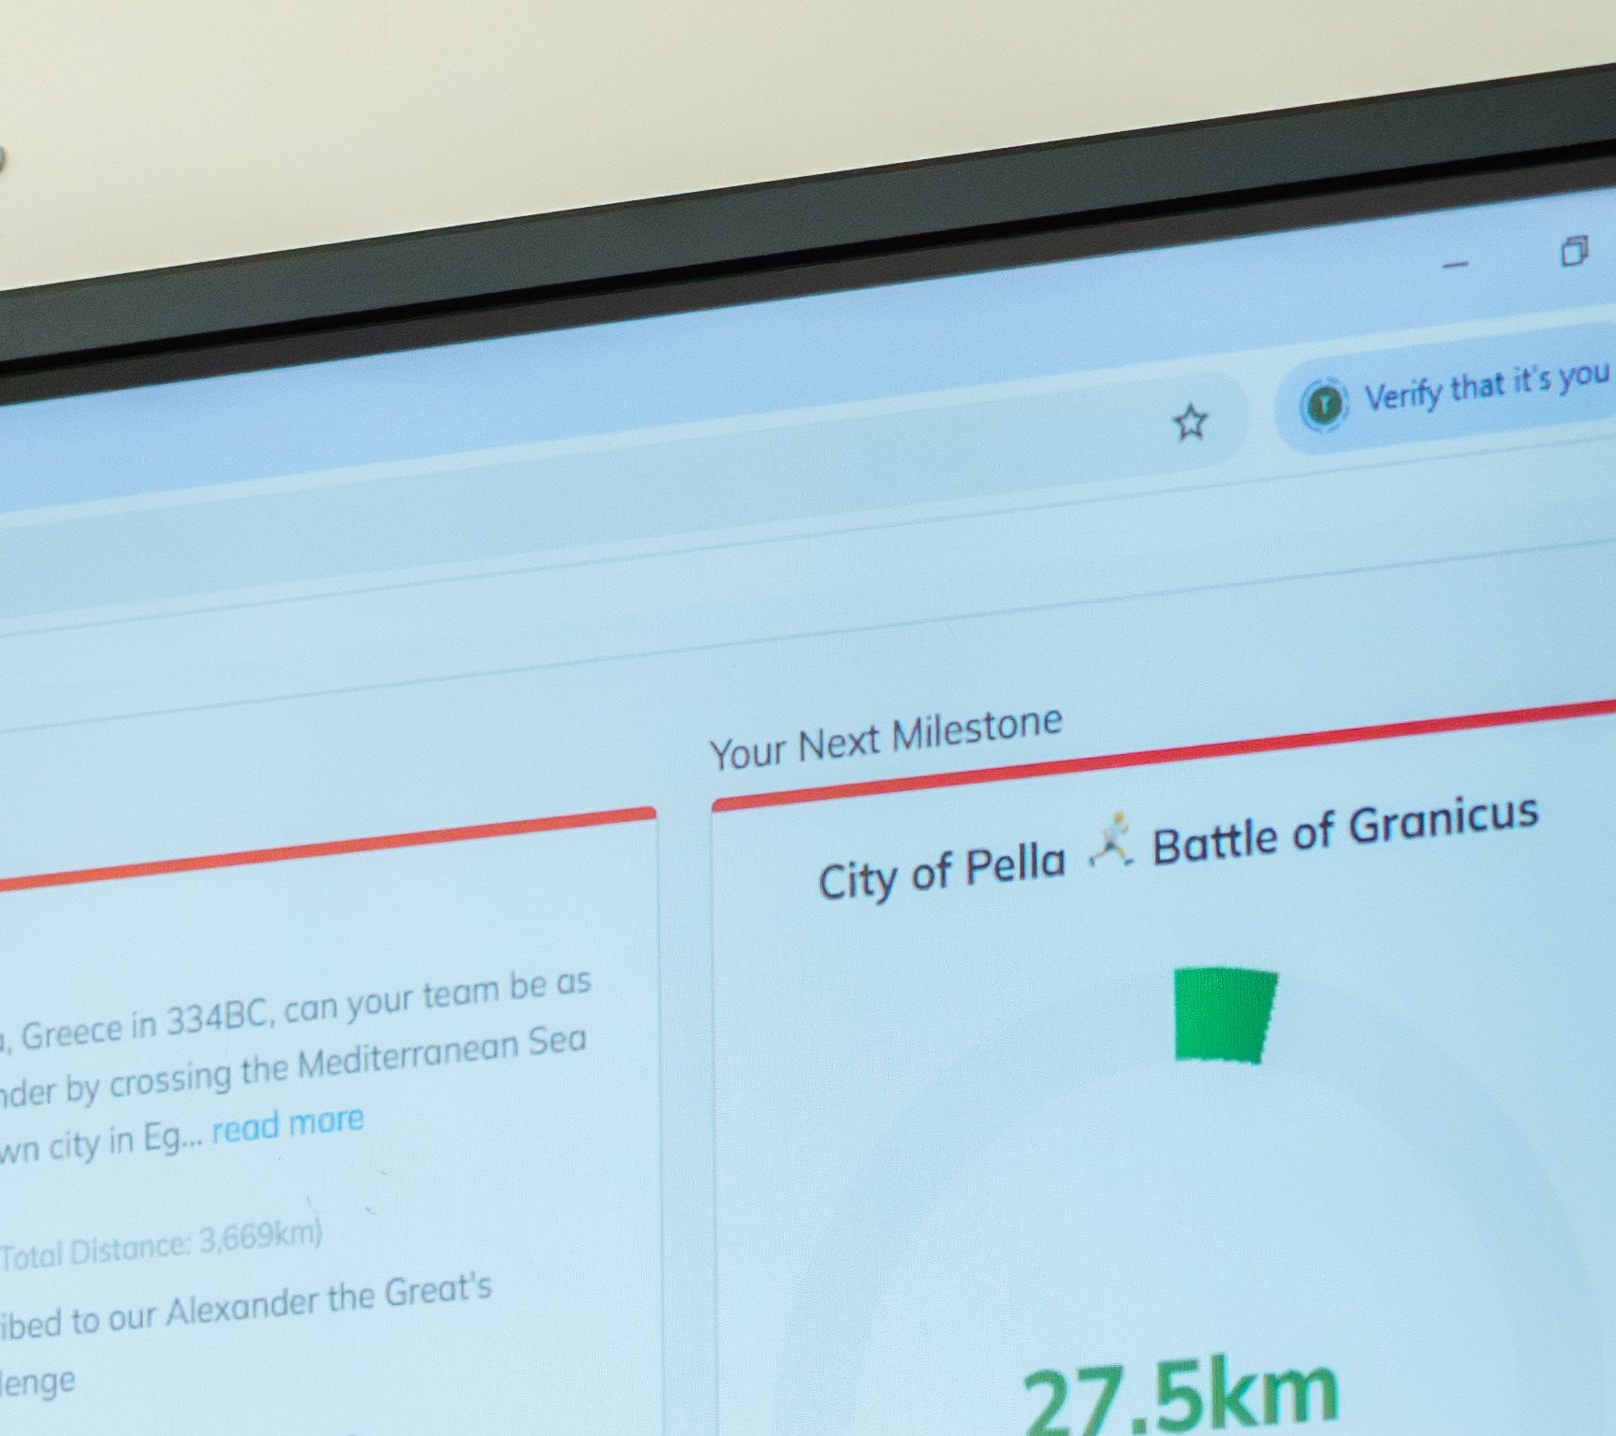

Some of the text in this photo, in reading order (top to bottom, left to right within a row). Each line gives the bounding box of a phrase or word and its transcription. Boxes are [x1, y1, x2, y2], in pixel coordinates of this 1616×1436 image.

[1363, 363, 1610, 415] Verify that it's you
[708, 709, 1064, 772] Your Next Milestone
[819, 796, 1540, 907] City of Pella Battle of Granicus
[21, 1020, 123, 1051] Greece
[131, 1010, 158, 1040] in
[167, 996, 276, 1037] 334BC,
[283, 997, 338, 1024] can
[346, 989, 415, 1026] your
[422, 980, 500, 1010] team
[510, 970, 548, 1001] be
[556, 970, 592, 996] as
[66, 1073, 101, 1109] by
[109, 1061, 232, 1099] crossing
[240, 1055, 289, 1086] the
[297, 1035, 520, 1079] Mediterranean
[528, 1025, 587, 1057] Sea
[49, 1130, 102, 1166] city
[109, 1125, 135, 1155] in
[212, 1109, 281, 1144] read
[289, 1108, 365, 1136] more
[69, 1235, 192, 1266] Distance:
[70, 1308, 101, 1335] to
[107, 1306, 158, 1333] our
[165, 1287, 320, 1327] Alexander
[326, 1282, 376, 1313] the
[384, 1270, 493, 1308] Great's
